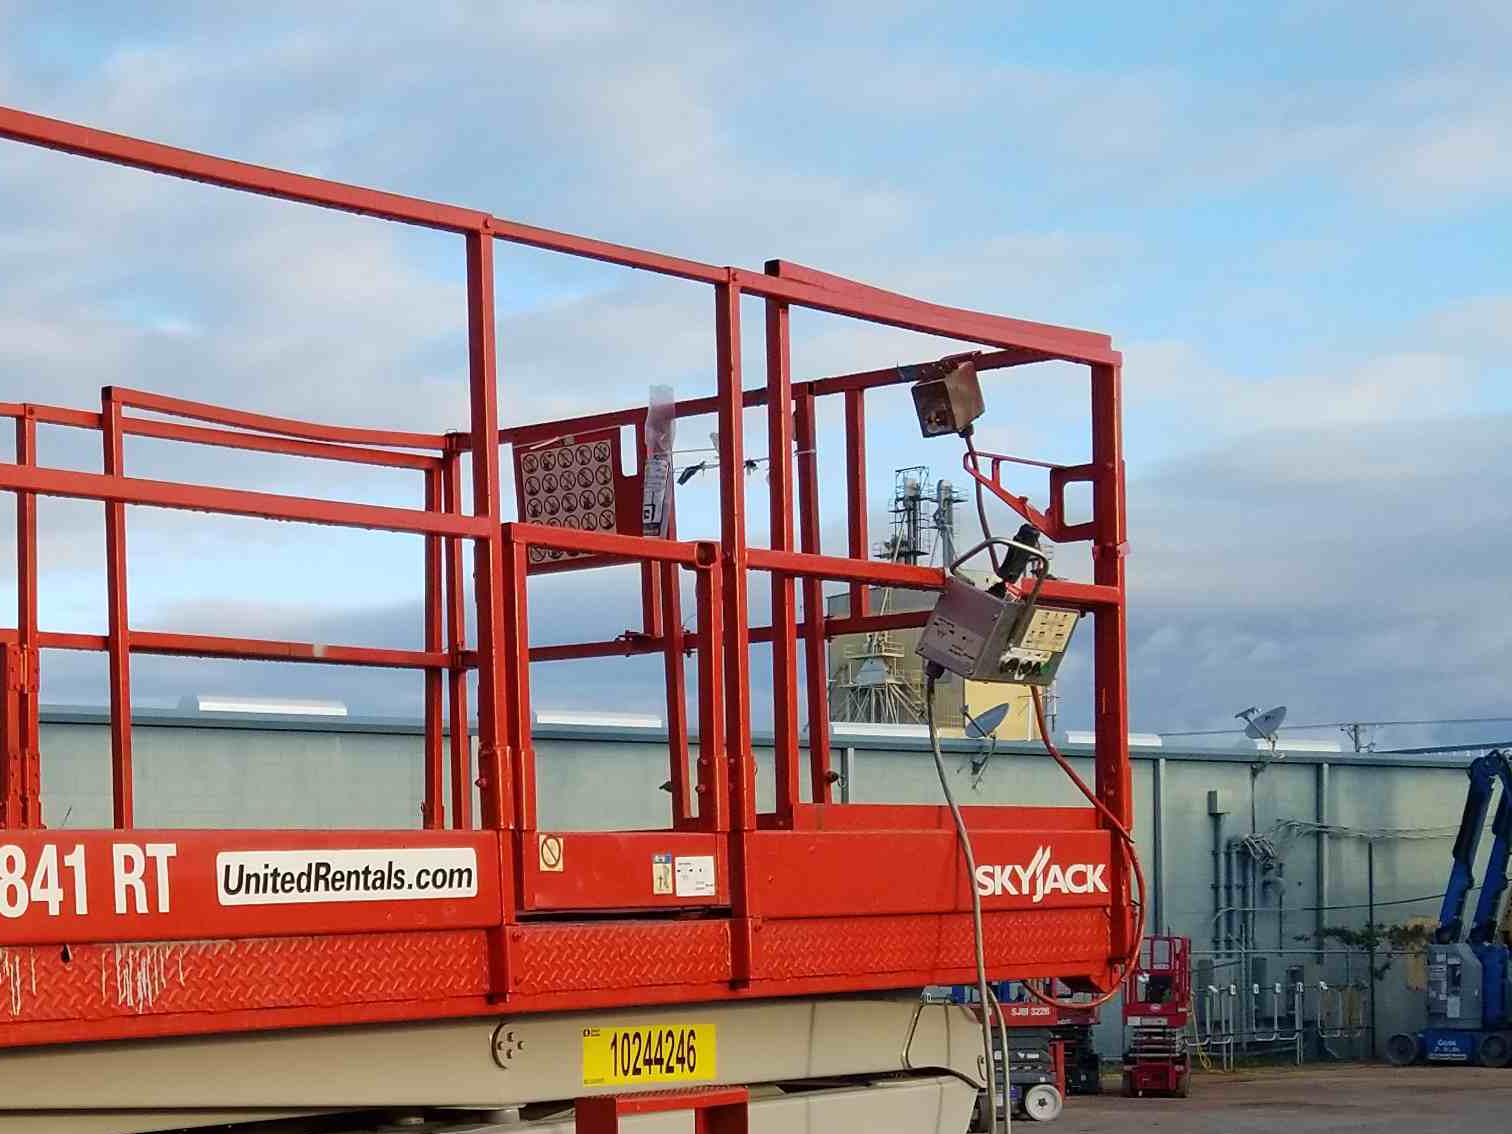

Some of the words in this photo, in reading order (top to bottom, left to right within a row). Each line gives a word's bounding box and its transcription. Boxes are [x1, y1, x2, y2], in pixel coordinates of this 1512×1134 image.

[112, 842, 177, 915] RT
[222, 861, 473, 896] UnitedRentals.com
[974, 845, 1109, 903] SKYJACK
[610, 1028, 697, 1077] 10244246
